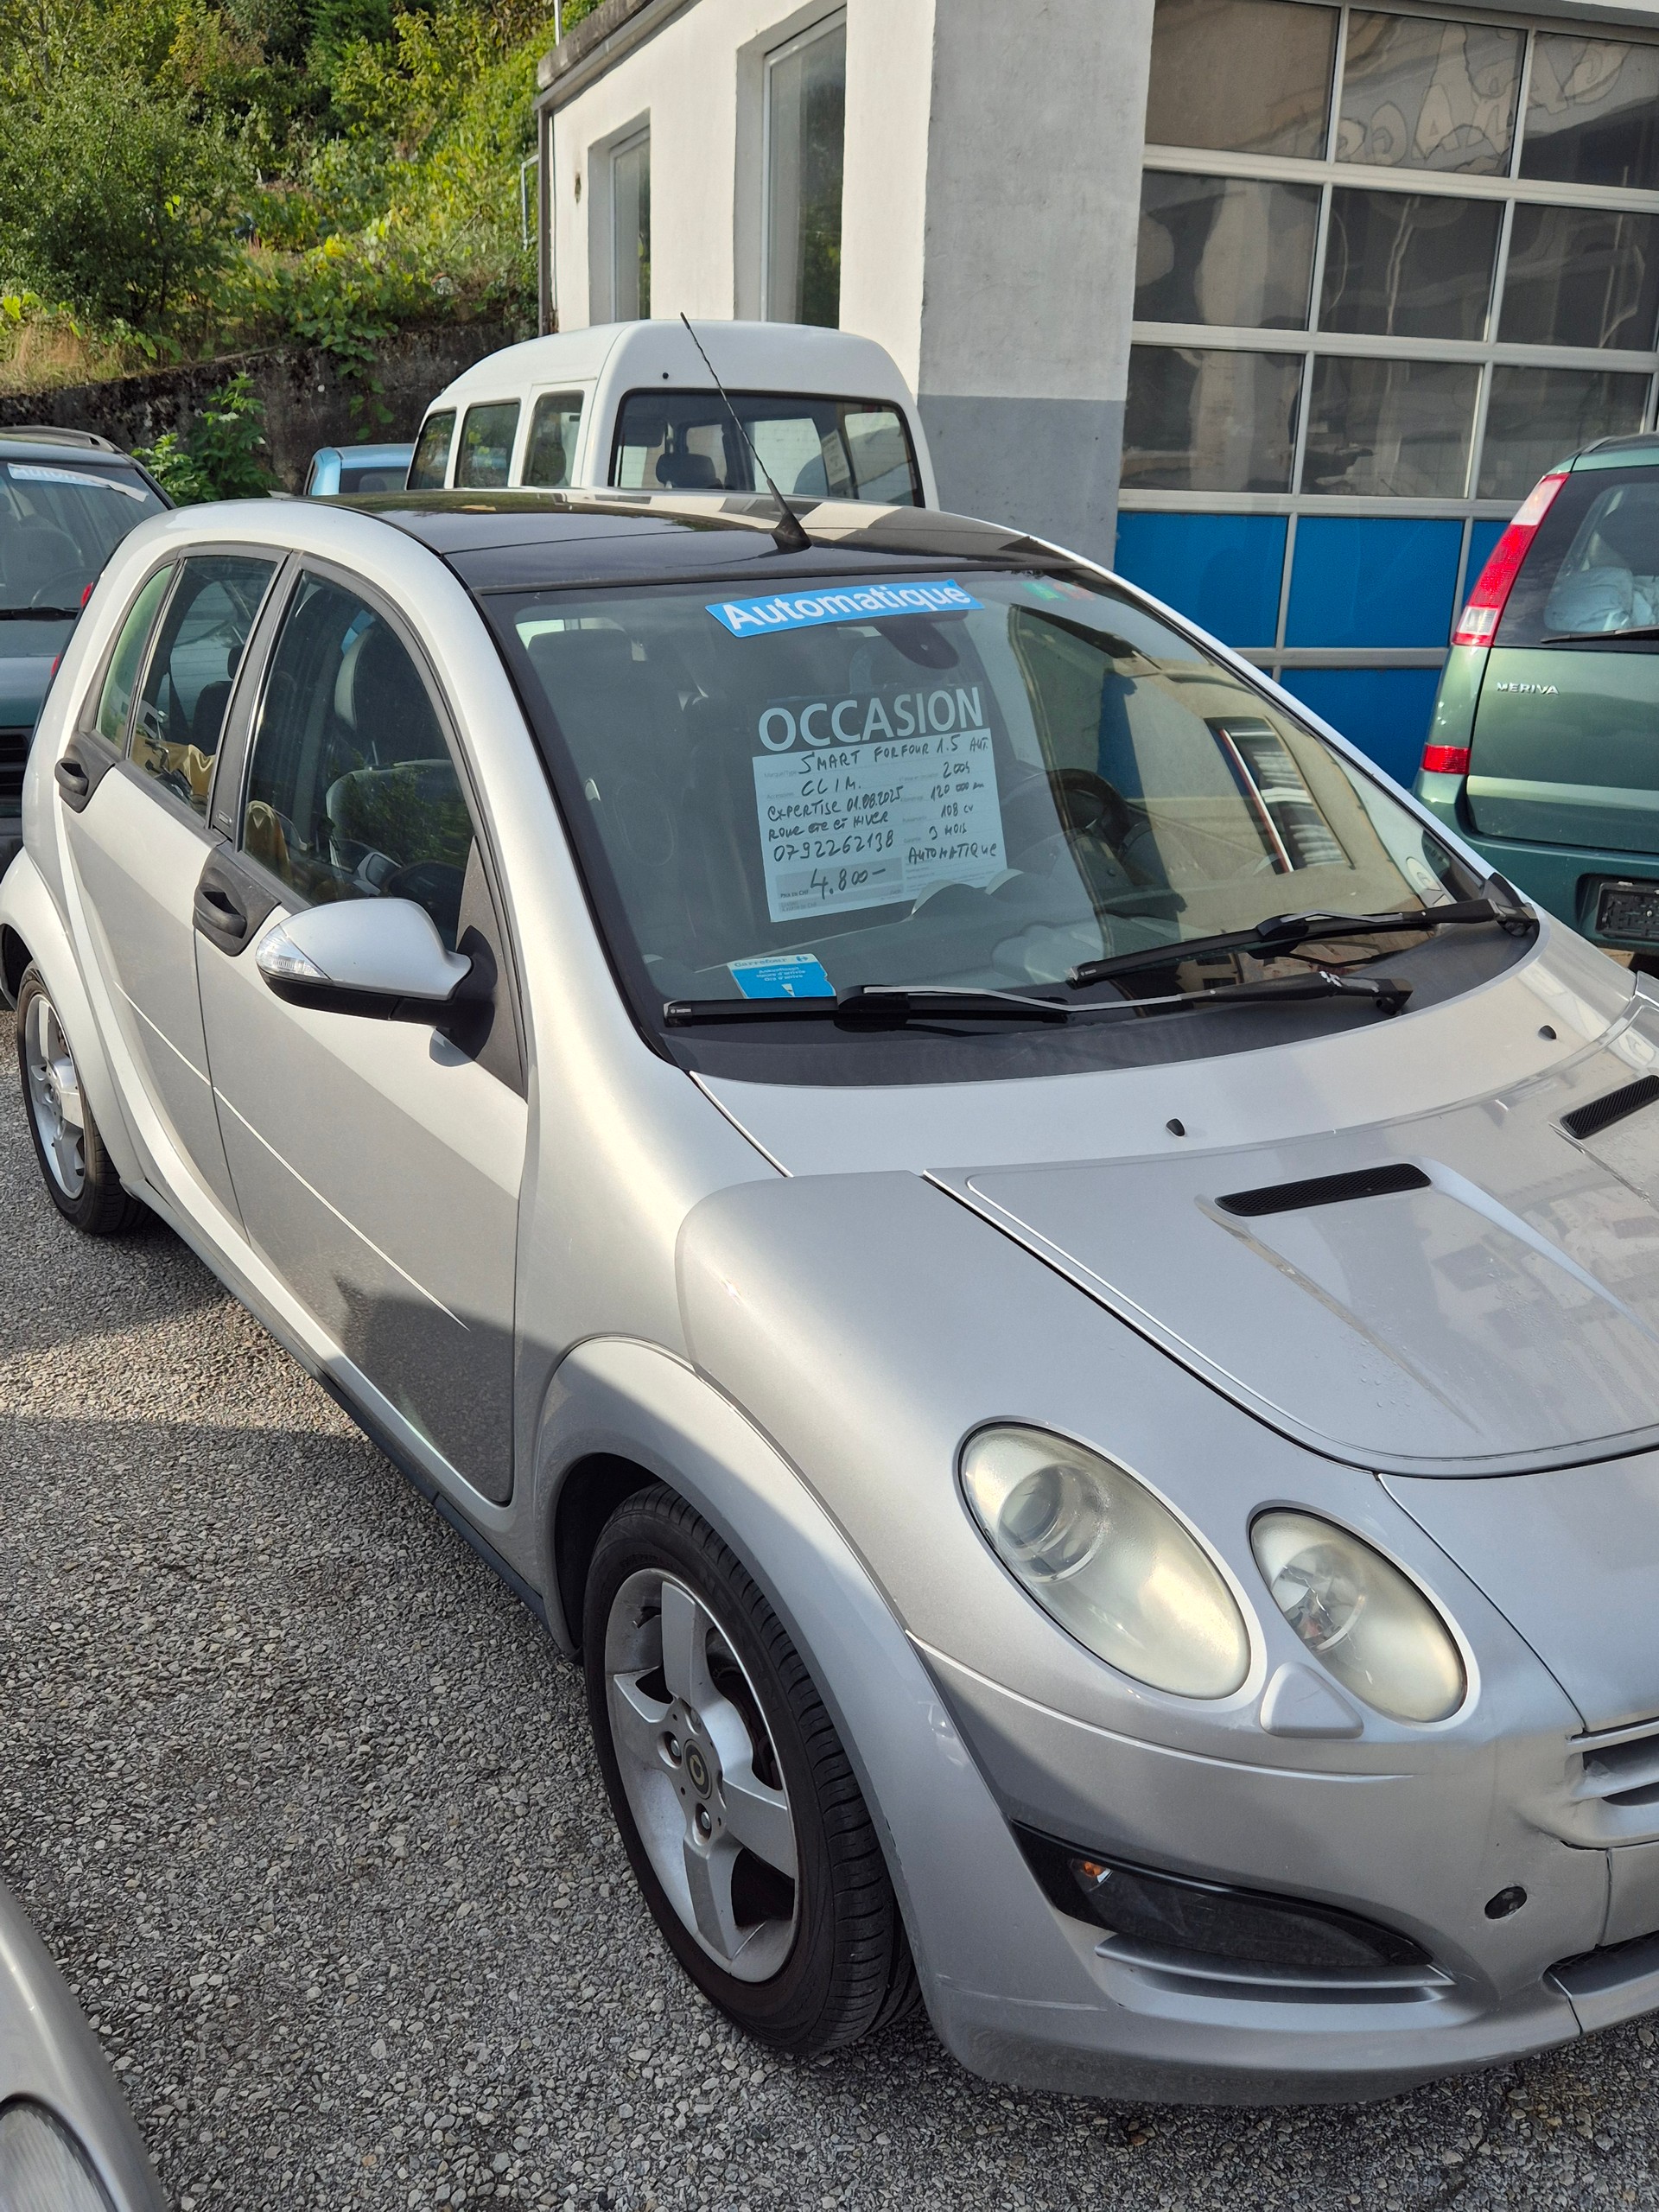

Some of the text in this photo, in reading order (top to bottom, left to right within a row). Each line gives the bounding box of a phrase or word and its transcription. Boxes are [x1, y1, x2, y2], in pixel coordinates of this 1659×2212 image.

[722, 585, 972, 630] Automatique
[1497, 682, 1560, 695] MERIVA
[758, 687, 984, 752] OCCASION
[798, 750, 861, 774] SMART
[874, 743, 930, 763] FORFOUR
[936, 734, 962, 753] 1.5
[801, 776, 861, 797] CLIM.
[931, 784, 950, 802] 120
[941, 802, 959, 818] 108
[773, 830, 894, 862] 0792262138
[734, 957, 787, 968] Carrefour
